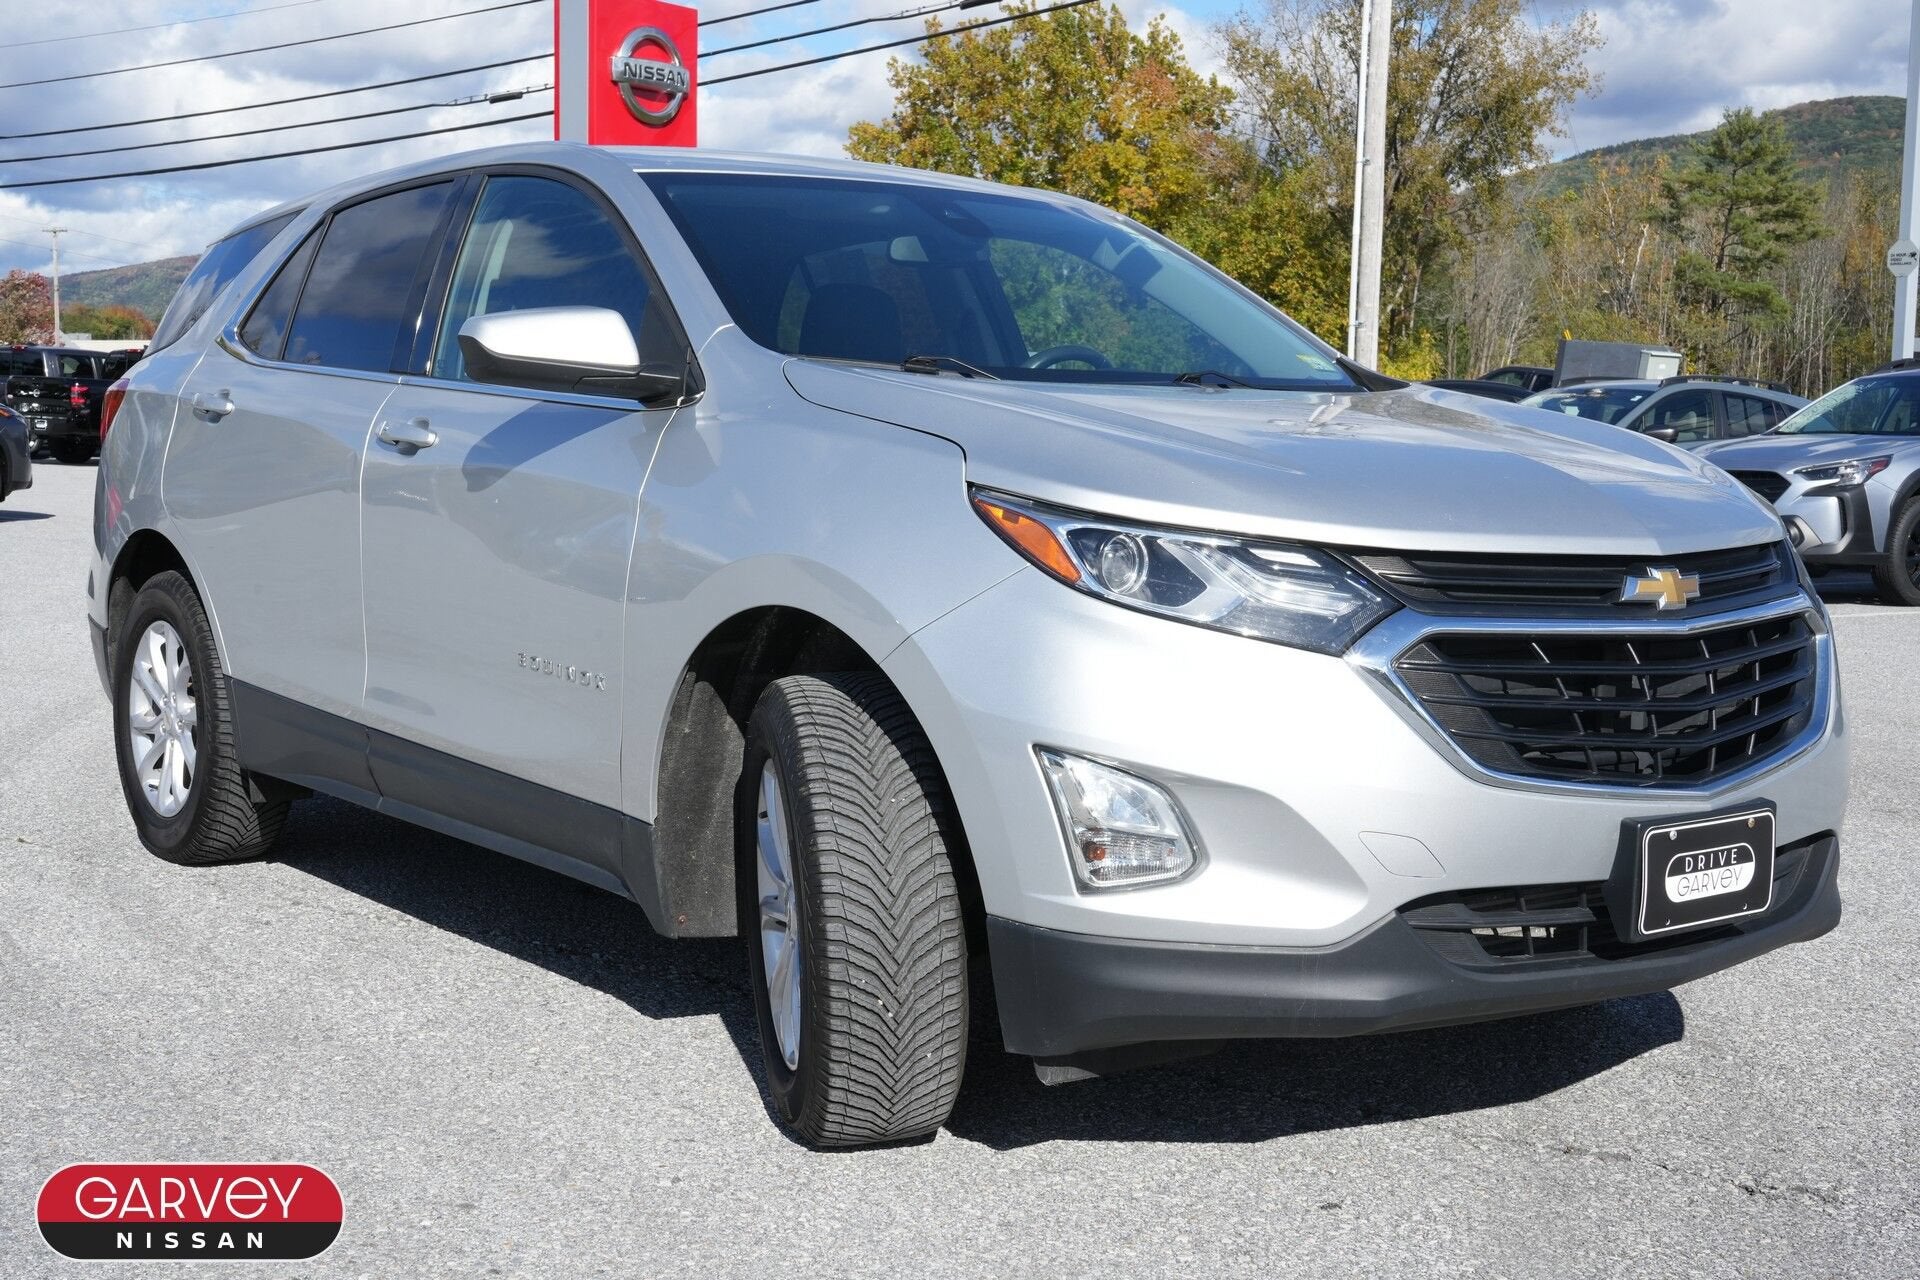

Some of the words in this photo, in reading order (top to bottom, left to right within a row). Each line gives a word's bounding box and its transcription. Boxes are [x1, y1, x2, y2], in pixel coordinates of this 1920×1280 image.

[623, 62, 687, 87] NISSAN
[518, 652, 608, 691] EQUINOX
[1685, 849, 1738, 872] DRIVE
